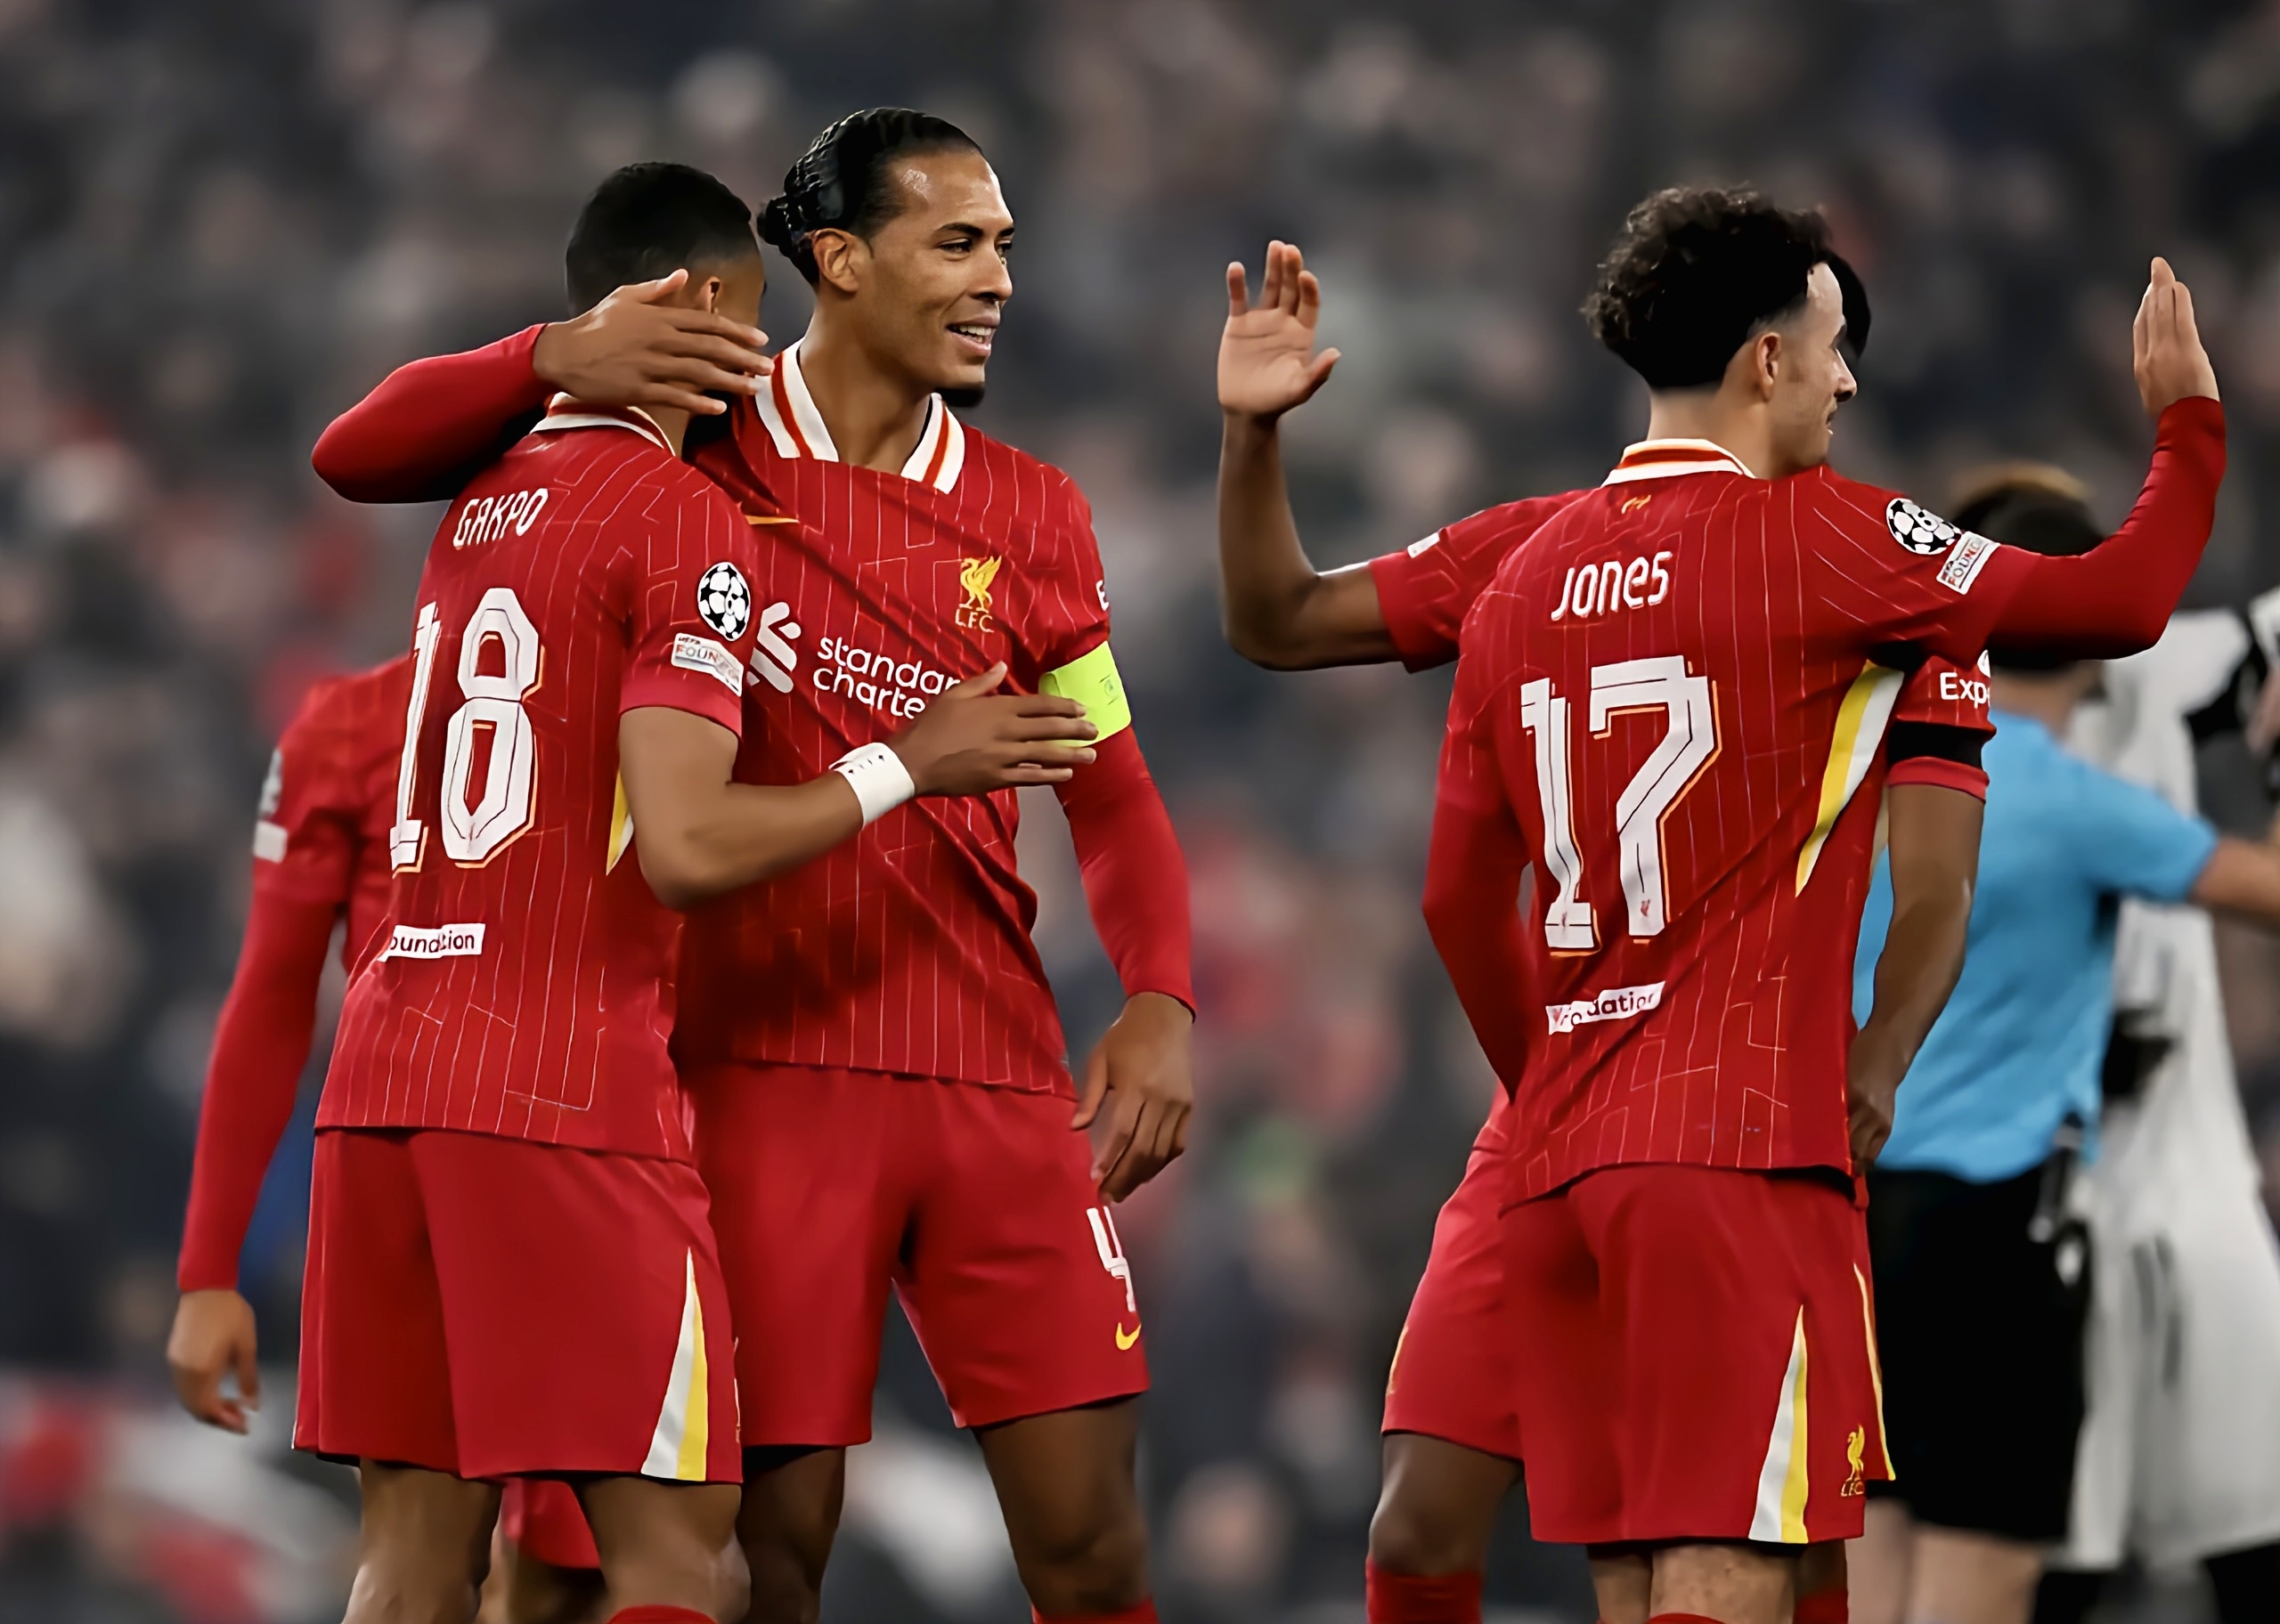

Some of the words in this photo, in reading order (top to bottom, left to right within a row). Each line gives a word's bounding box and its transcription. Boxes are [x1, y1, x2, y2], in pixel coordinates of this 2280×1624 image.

[452, 487, 549, 548] GAKPO
[955, 608, 994, 632] LFC
[812, 666, 926, 719] charte
[817, 637, 961, 695] standar
[1939, 671, 1991, 709] Exp
[389, 588, 544, 878] 18
[1520, 655, 1722, 957] 17
[1086, 1206, 1136, 1313] 4
